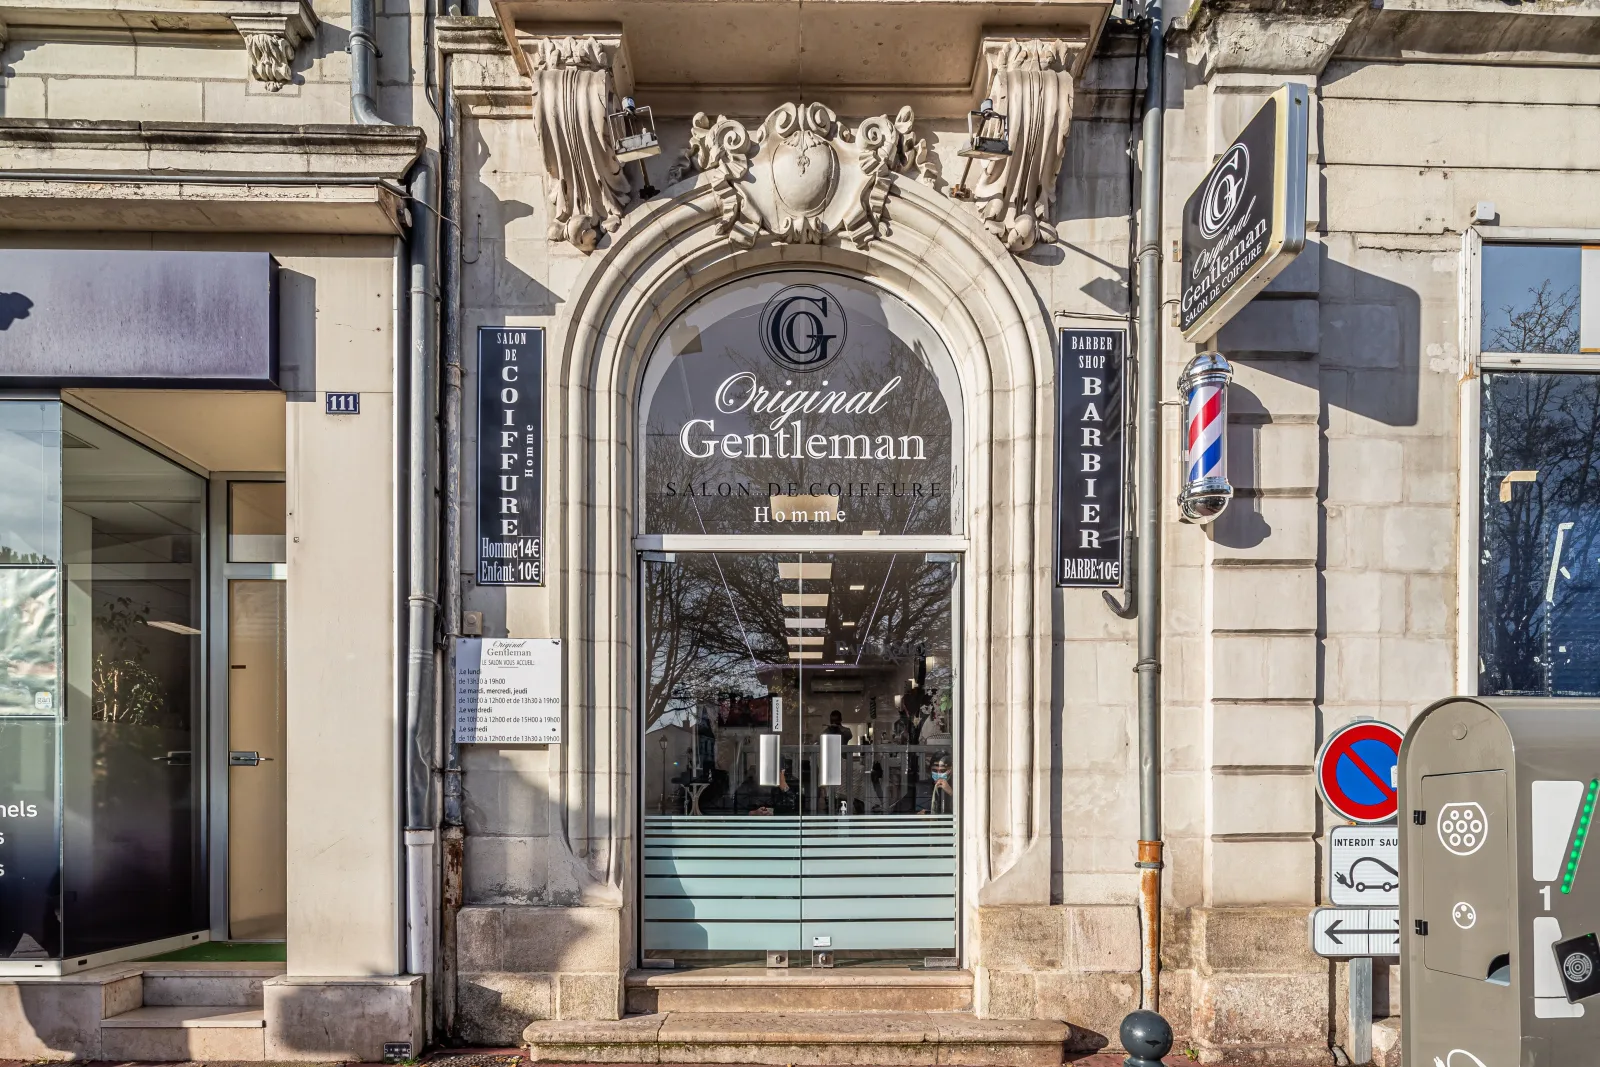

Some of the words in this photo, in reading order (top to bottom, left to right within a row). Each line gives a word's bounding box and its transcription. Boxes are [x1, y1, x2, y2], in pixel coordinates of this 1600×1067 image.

[1192, 195, 1257, 280] Original
[1181, 218, 1268, 313] Gentleman
[1184, 296, 1208, 326] SALON
[1209, 283, 1221, 302] DE
[1221, 242, 1262, 288] COIFFURE
[496, 332, 527, 345] SALON
[1072, 336, 1113, 351] BARBER
[505, 349, 517, 361] DE
[1079, 355, 1106, 369] SHOP
[330, 395, 355, 411] 111
[714, 371, 902, 431] Original
[679, 418, 927, 460] Gentleman
[499, 366, 519, 536] COIFFURE
[524, 424, 534, 478] Homme
[1079, 376, 1103, 549] BARBIER
[666, 482, 750, 498] SALON
[768, 482, 798, 498] DE
[809, 482, 942, 498] COIFFURE
[754, 506, 846, 523] Homme
[482, 537, 518, 559] Homme
[518, 538, 540, 558] 14€
[481, 560, 515, 582] Enfant:
[518, 561, 540, 581] 10€
[486, 648, 532, 657] Gentleman
[492, 640, 528, 651] Original
[513, 687, 528, 696] jeudi
[1334, 838, 1375, 847] INTERDIT
[1539, 885, 1551, 911] 1
